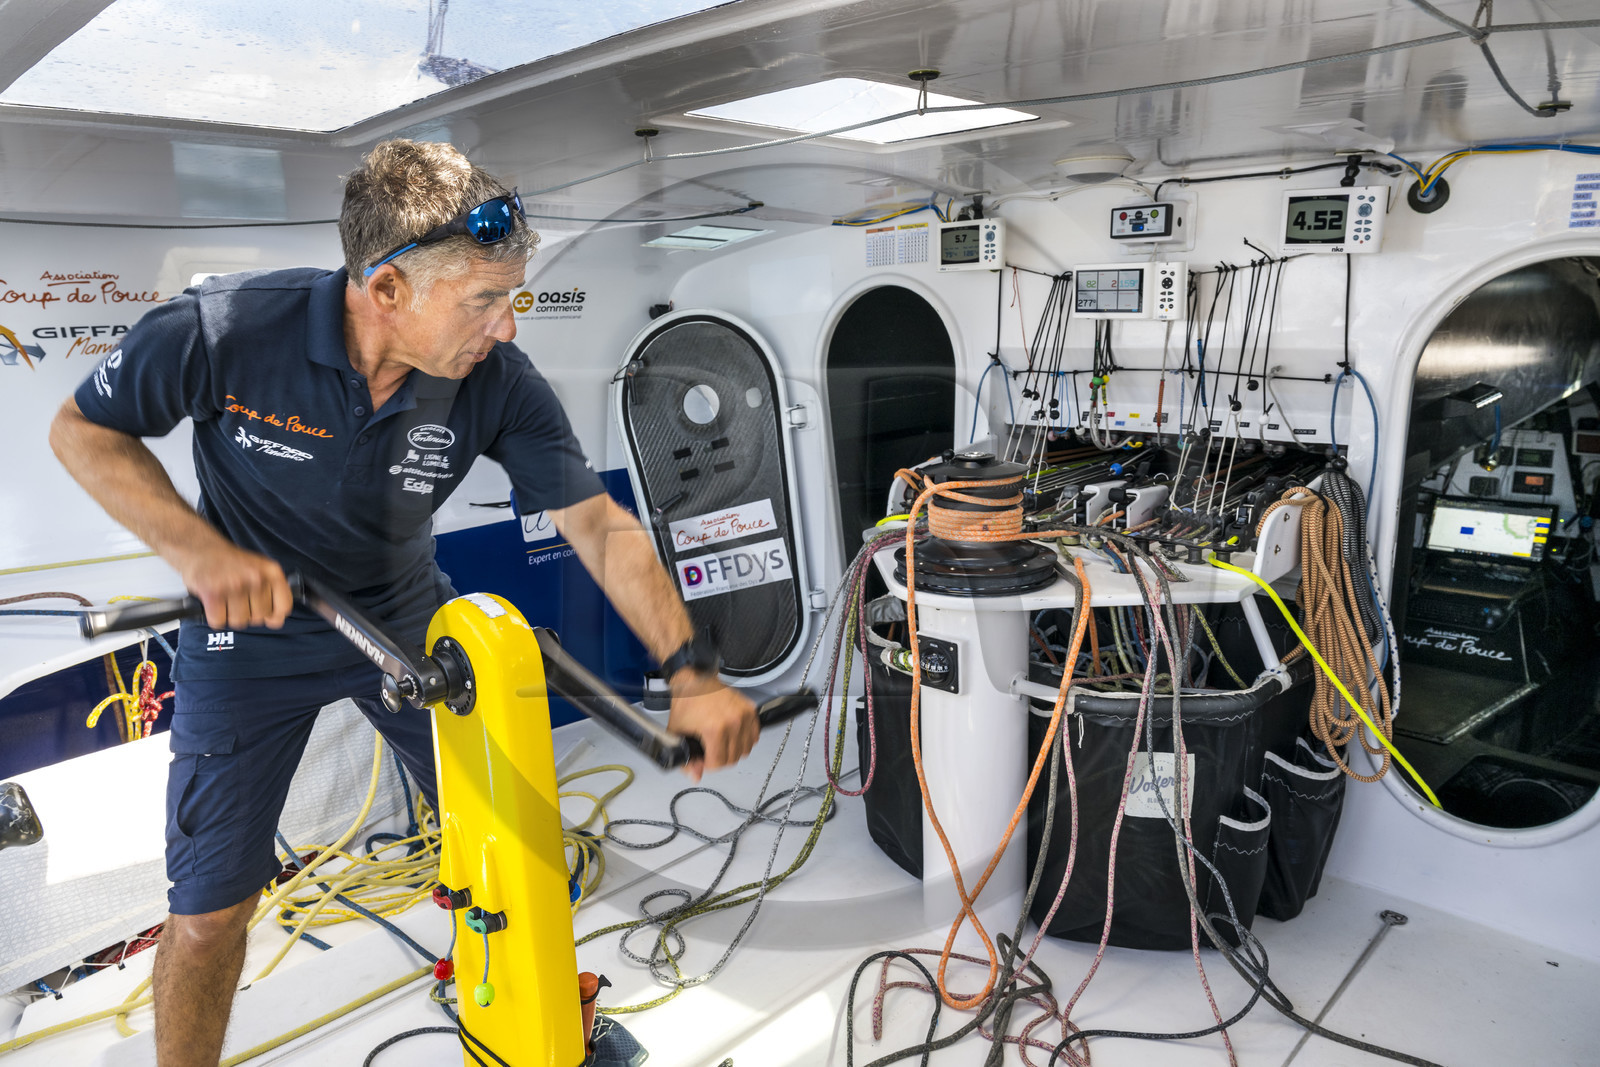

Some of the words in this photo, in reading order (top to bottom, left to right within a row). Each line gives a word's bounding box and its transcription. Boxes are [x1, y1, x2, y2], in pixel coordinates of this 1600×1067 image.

[1292, 210, 1344, 231] 4.52
[40, 271, 119, 281] Association
[67, 287, 97, 303] de
[100, 281, 169, 305] Pouce
[538, 287, 586, 304] oasis
[536, 304, 583, 312] commerce
[32, 325, 131, 339] GIFFA
[263, 413, 285, 427] de
[284, 415, 334, 439] Pouce
[676, 530, 711, 546] Coup
[714, 526, 729, 538] de
[730, 517, 770, 535] Pouce
[528, 552, 551, 565] Expert
[552, 551, 562, 560] en
[206, 631, 235, 646] HH
[335, 612, 385, 666] HARKEN
[1434, 639, 1457, 651] de
[1459, 640, 1513, 660] Pouce
